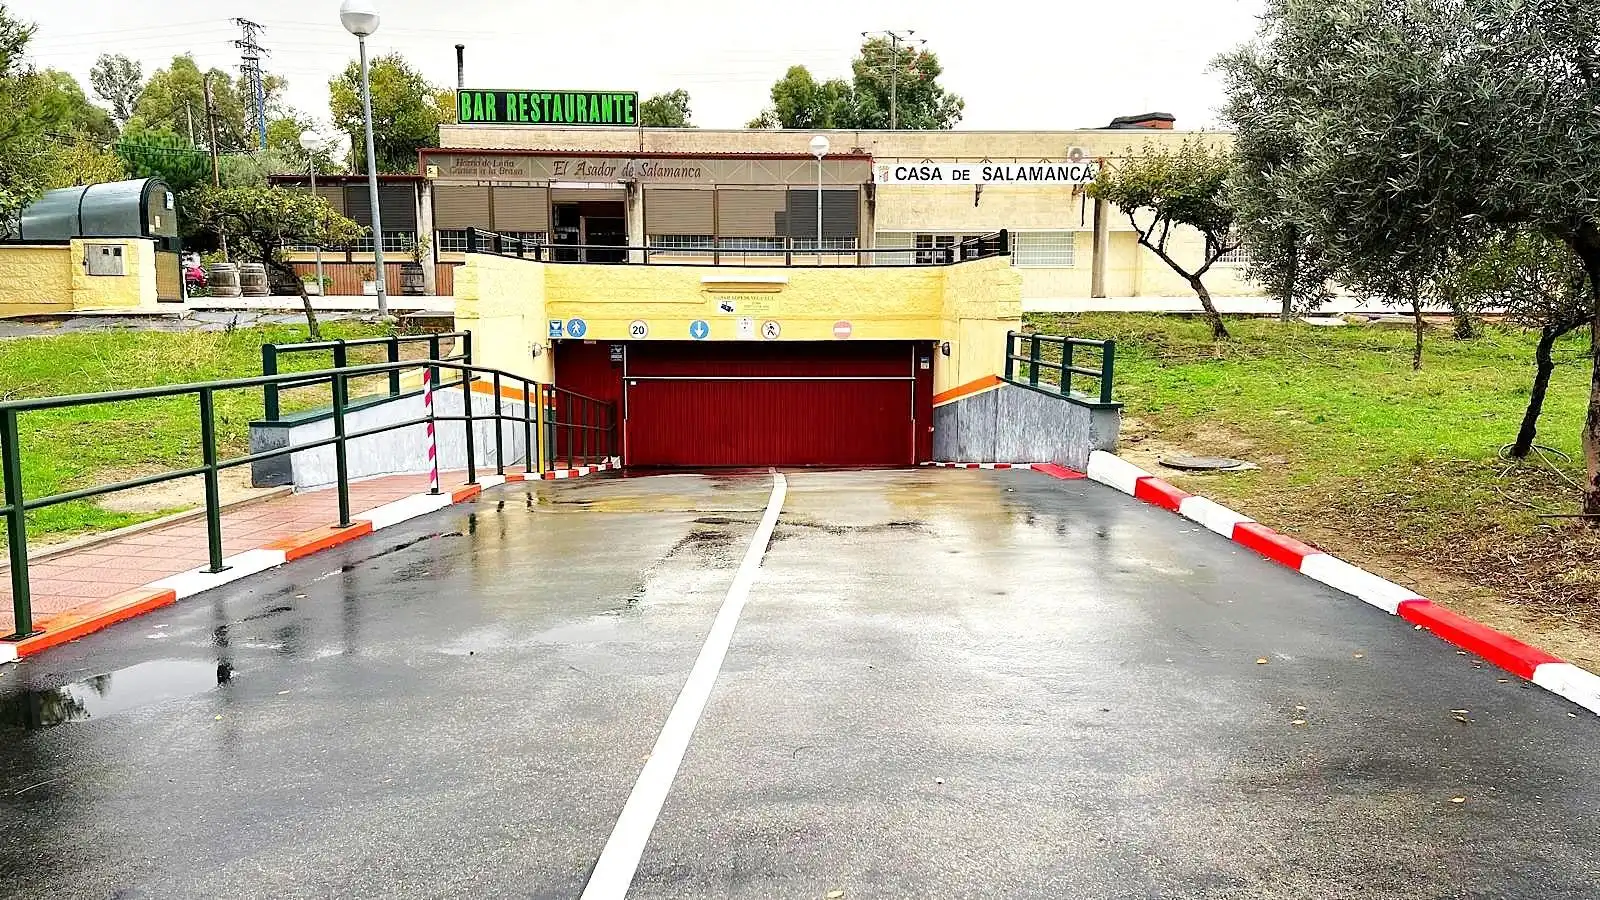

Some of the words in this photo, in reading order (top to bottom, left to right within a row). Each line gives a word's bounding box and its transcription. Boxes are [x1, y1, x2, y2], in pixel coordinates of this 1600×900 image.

[461, 92, 497, 121] BAR
[506, 93, 634, 123] RESTAURANTE
[553, 161, 569, 176] El
[574, 161, 616, 177] Asador
[622, 162, 634, 177] de
[638, 162, 701, 178] Salamanca
[895, 166, 942, 181] CASA
[952, 169, 970, 181] DE
[982, 166, 1094, 181] SALAMANCA
[632, 326, 645, 335] 20
